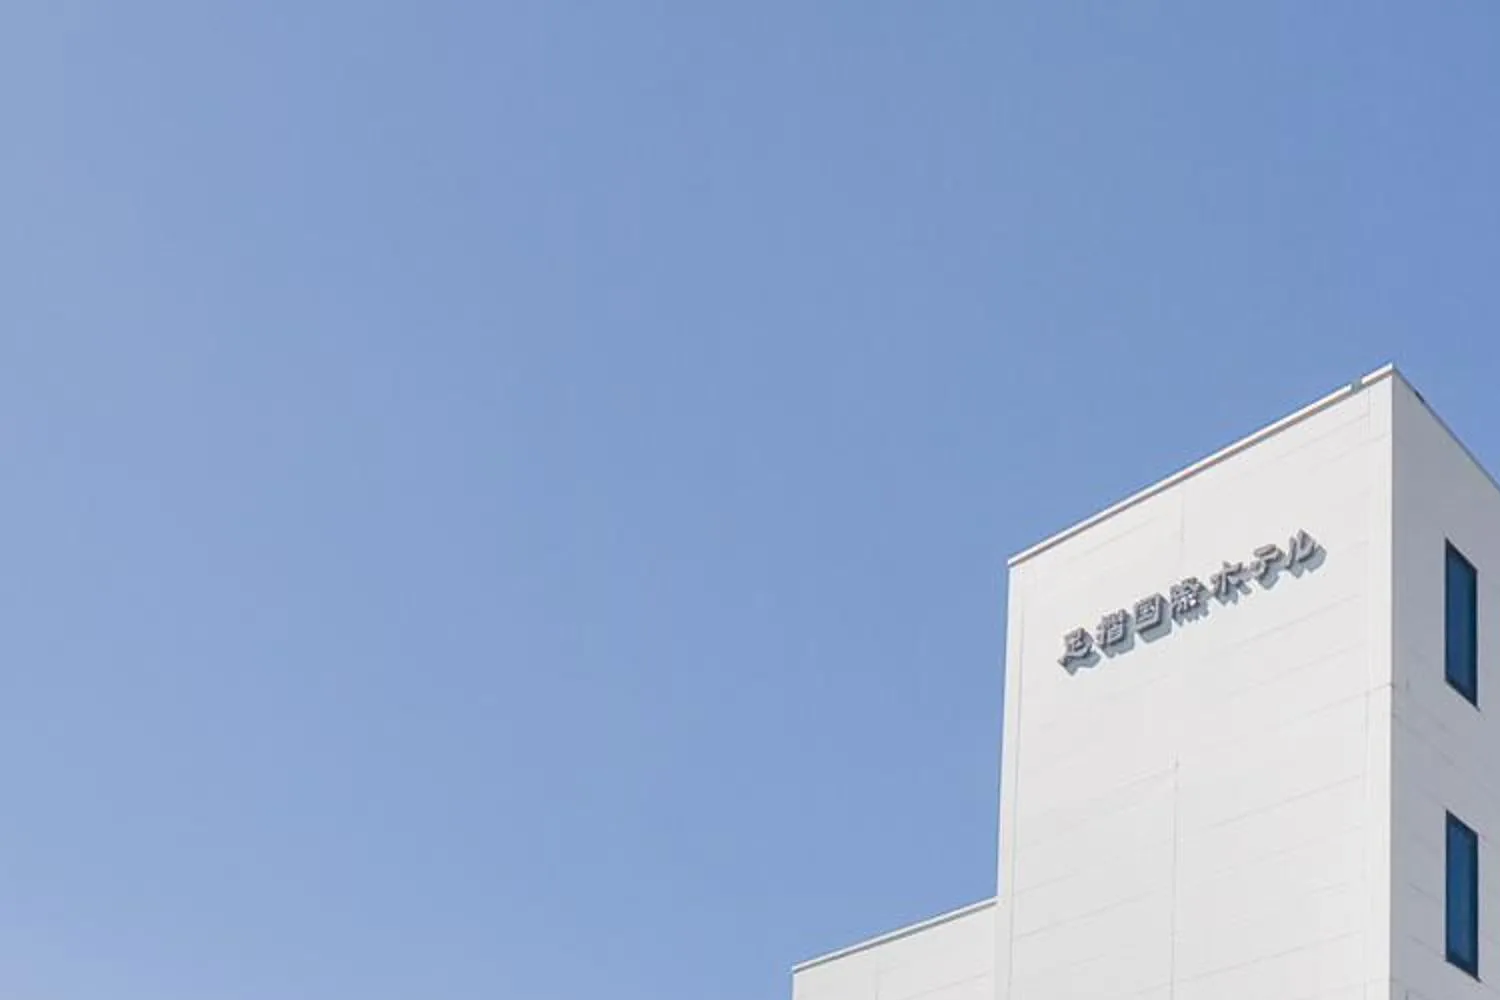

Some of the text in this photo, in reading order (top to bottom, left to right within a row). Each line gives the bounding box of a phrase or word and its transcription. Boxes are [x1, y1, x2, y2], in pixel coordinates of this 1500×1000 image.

[1058, 529, 1325, 672] 足摺国際ホテル
